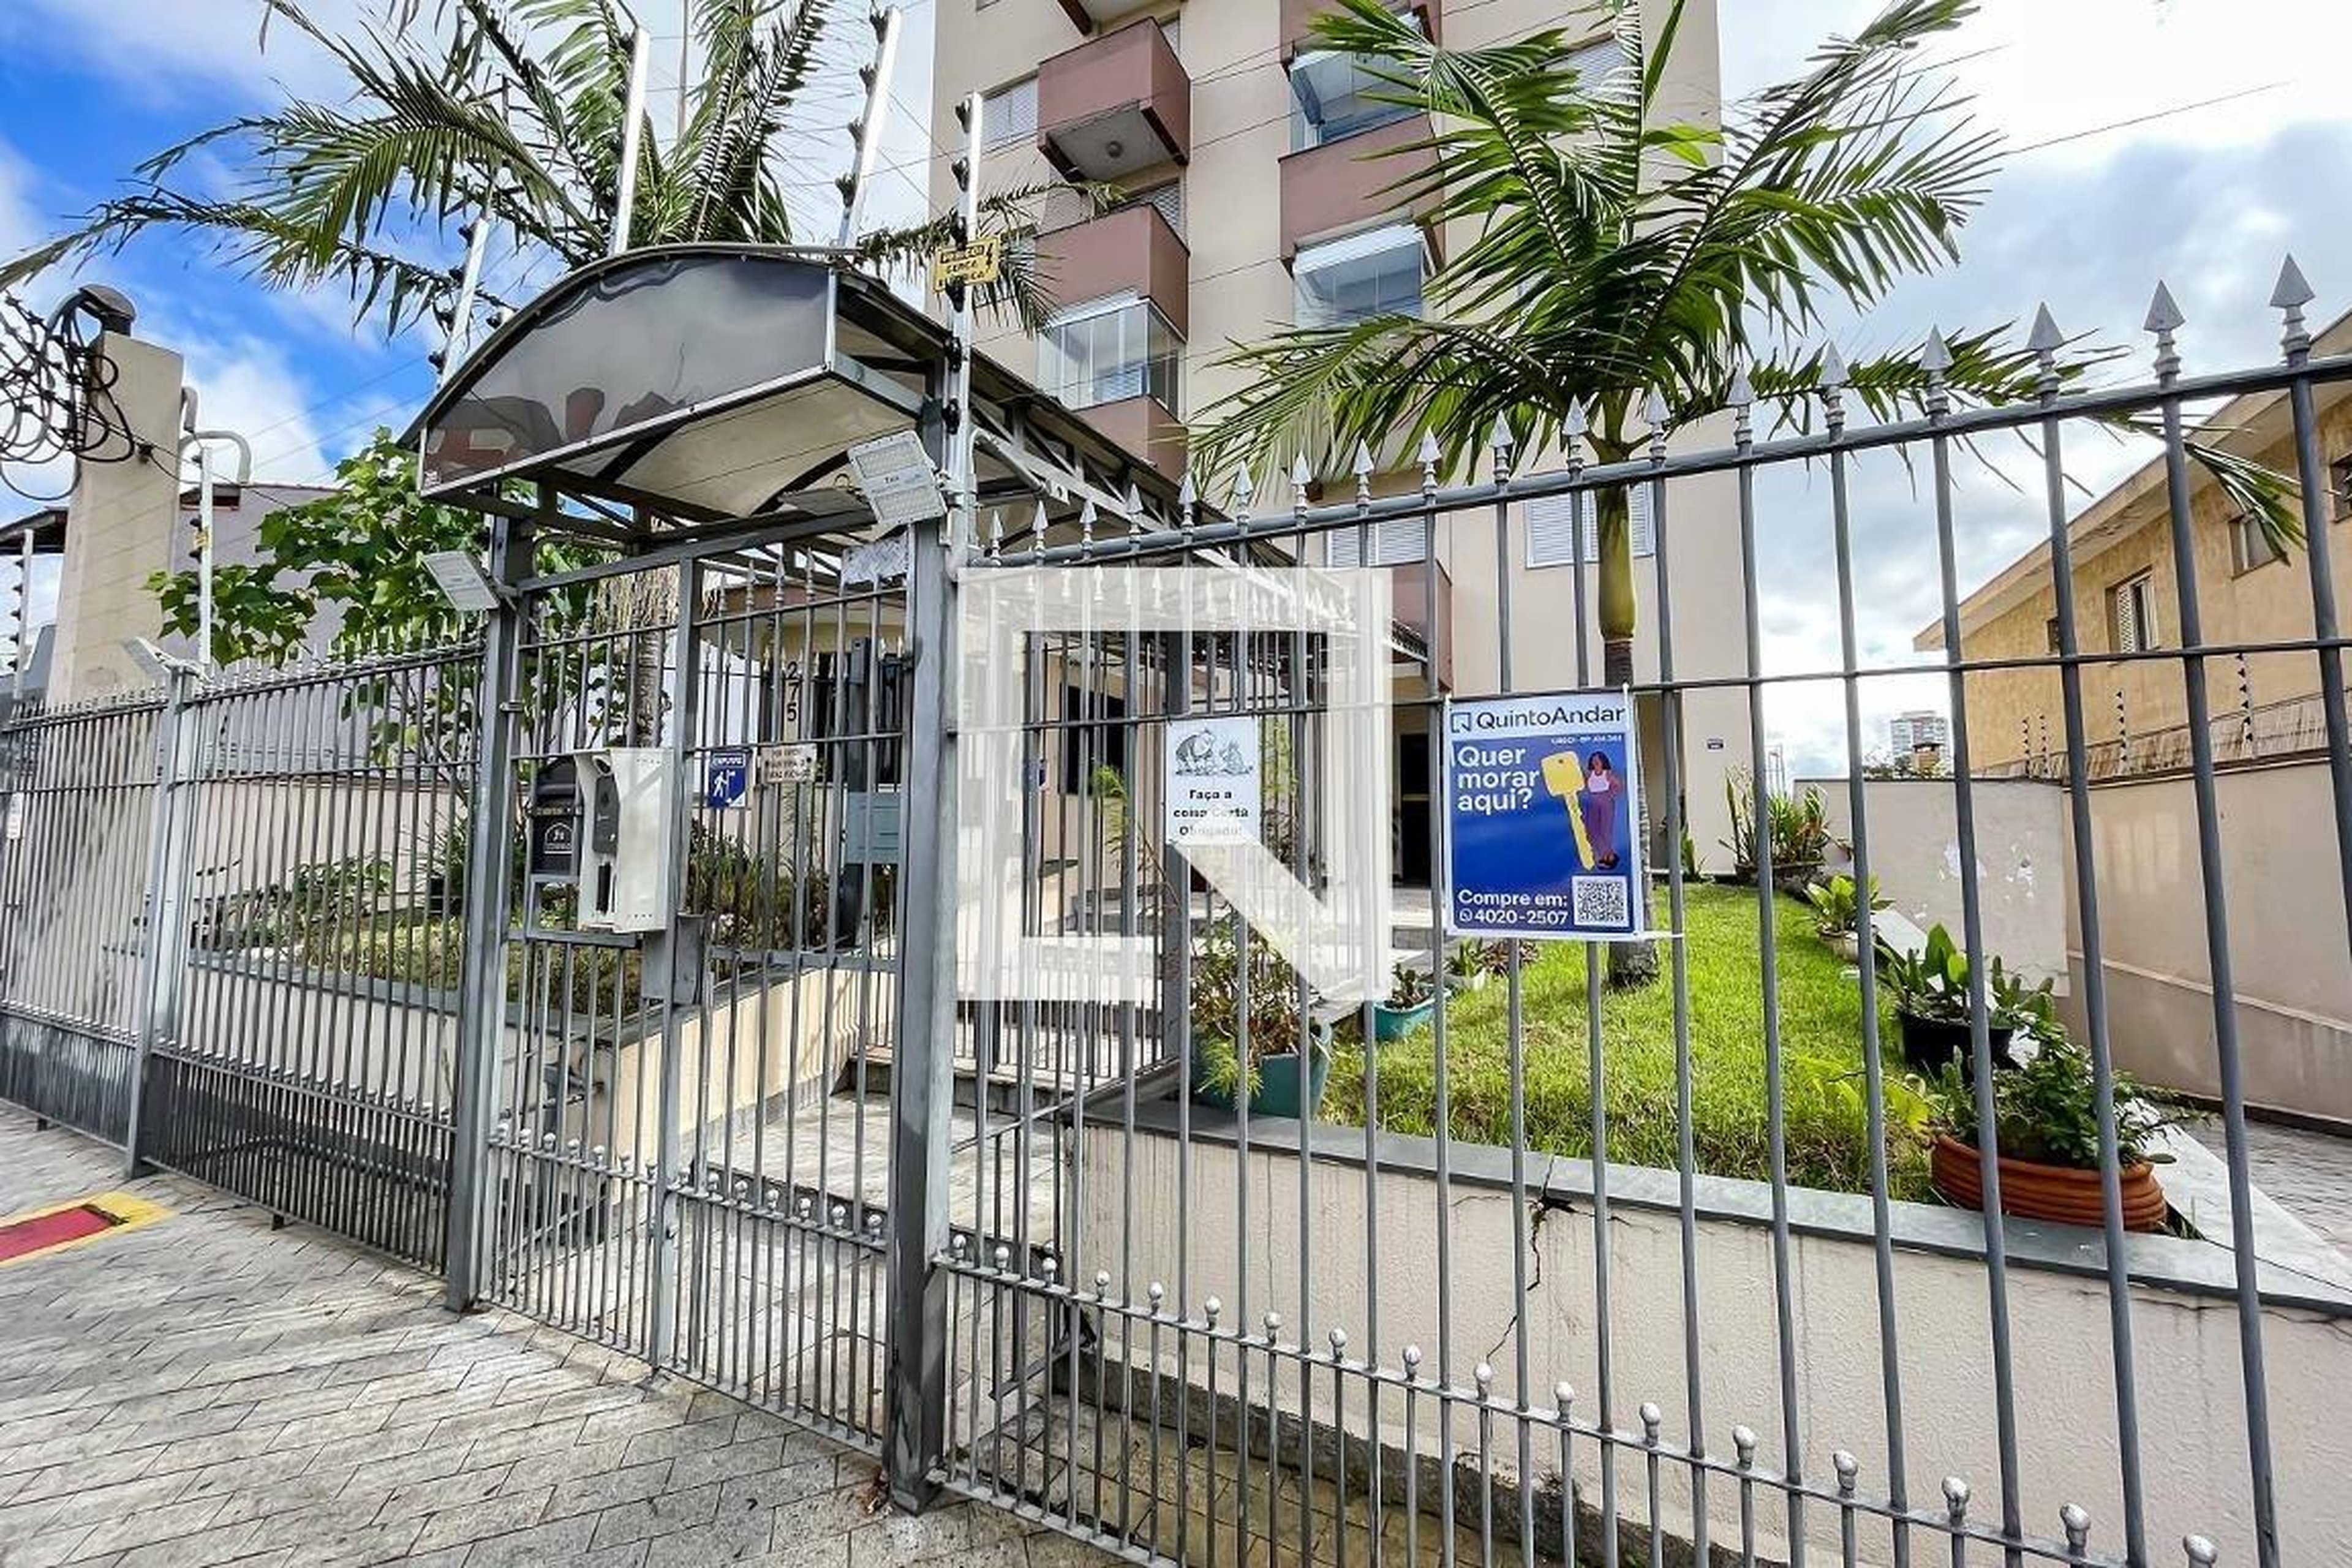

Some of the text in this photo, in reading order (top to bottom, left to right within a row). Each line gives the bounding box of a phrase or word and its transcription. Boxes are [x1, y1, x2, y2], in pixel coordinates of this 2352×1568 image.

[787, 661, 799, 722] 275
[1477, 705, 1626, 729] QuintoAndar
[1458, 746, 1526, 767] Quer
[1458, 770, 1539, 789] morar
[1189, 789, 1232, 801] Faça a
[1458, 788, 1532, 815] aqui?
[1173, 807, 1208, 818] coisa
[1458, 889, 1568, 908] Compre em:
[1474, 909, 1569, 925] 4020-2507
